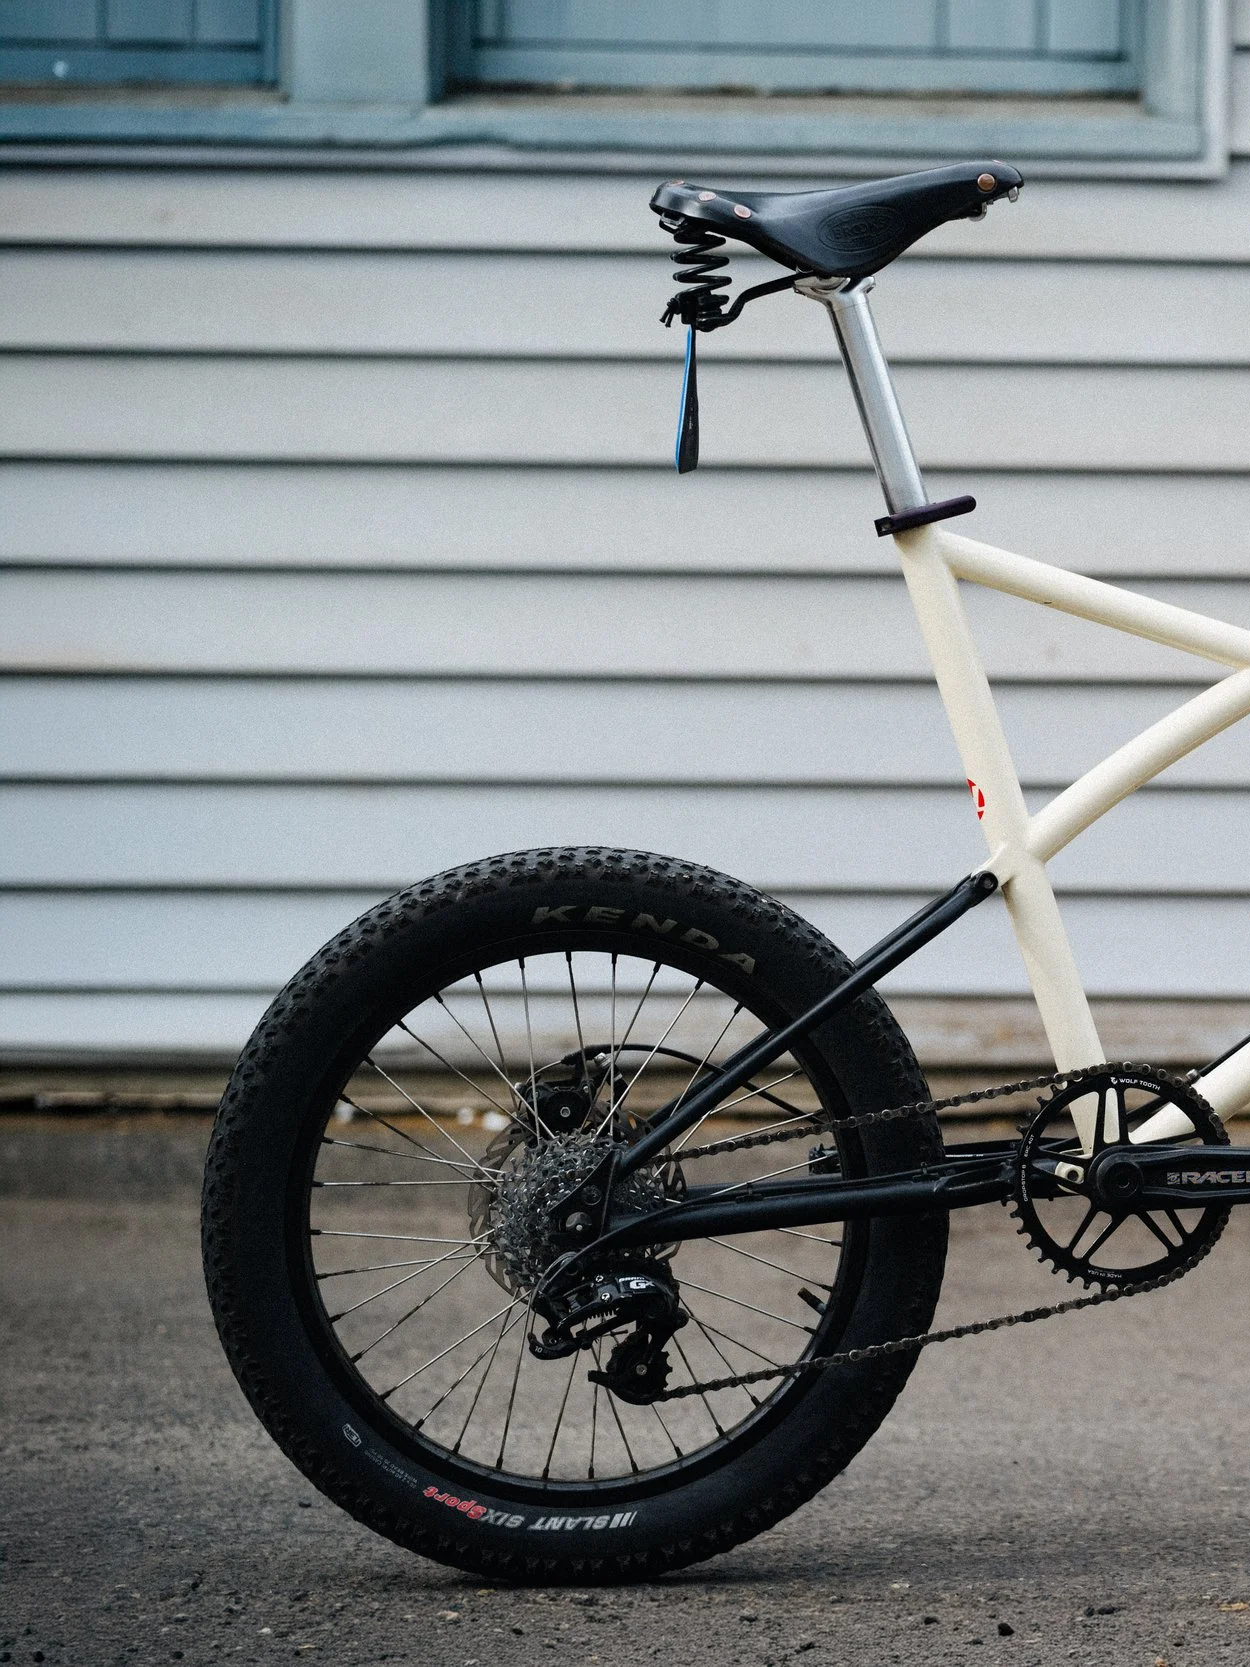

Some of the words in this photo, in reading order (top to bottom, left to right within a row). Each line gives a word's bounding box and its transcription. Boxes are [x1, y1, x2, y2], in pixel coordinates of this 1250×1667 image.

[531, 905, 755, 974] KENDA
[1139, 1080, 1161, 1091] TOOTH
[423, 1486, 488, 1520] Sport
[484, 1508, 525, 1528] SIX
[527, 1514, 610, 1531] SLANT
